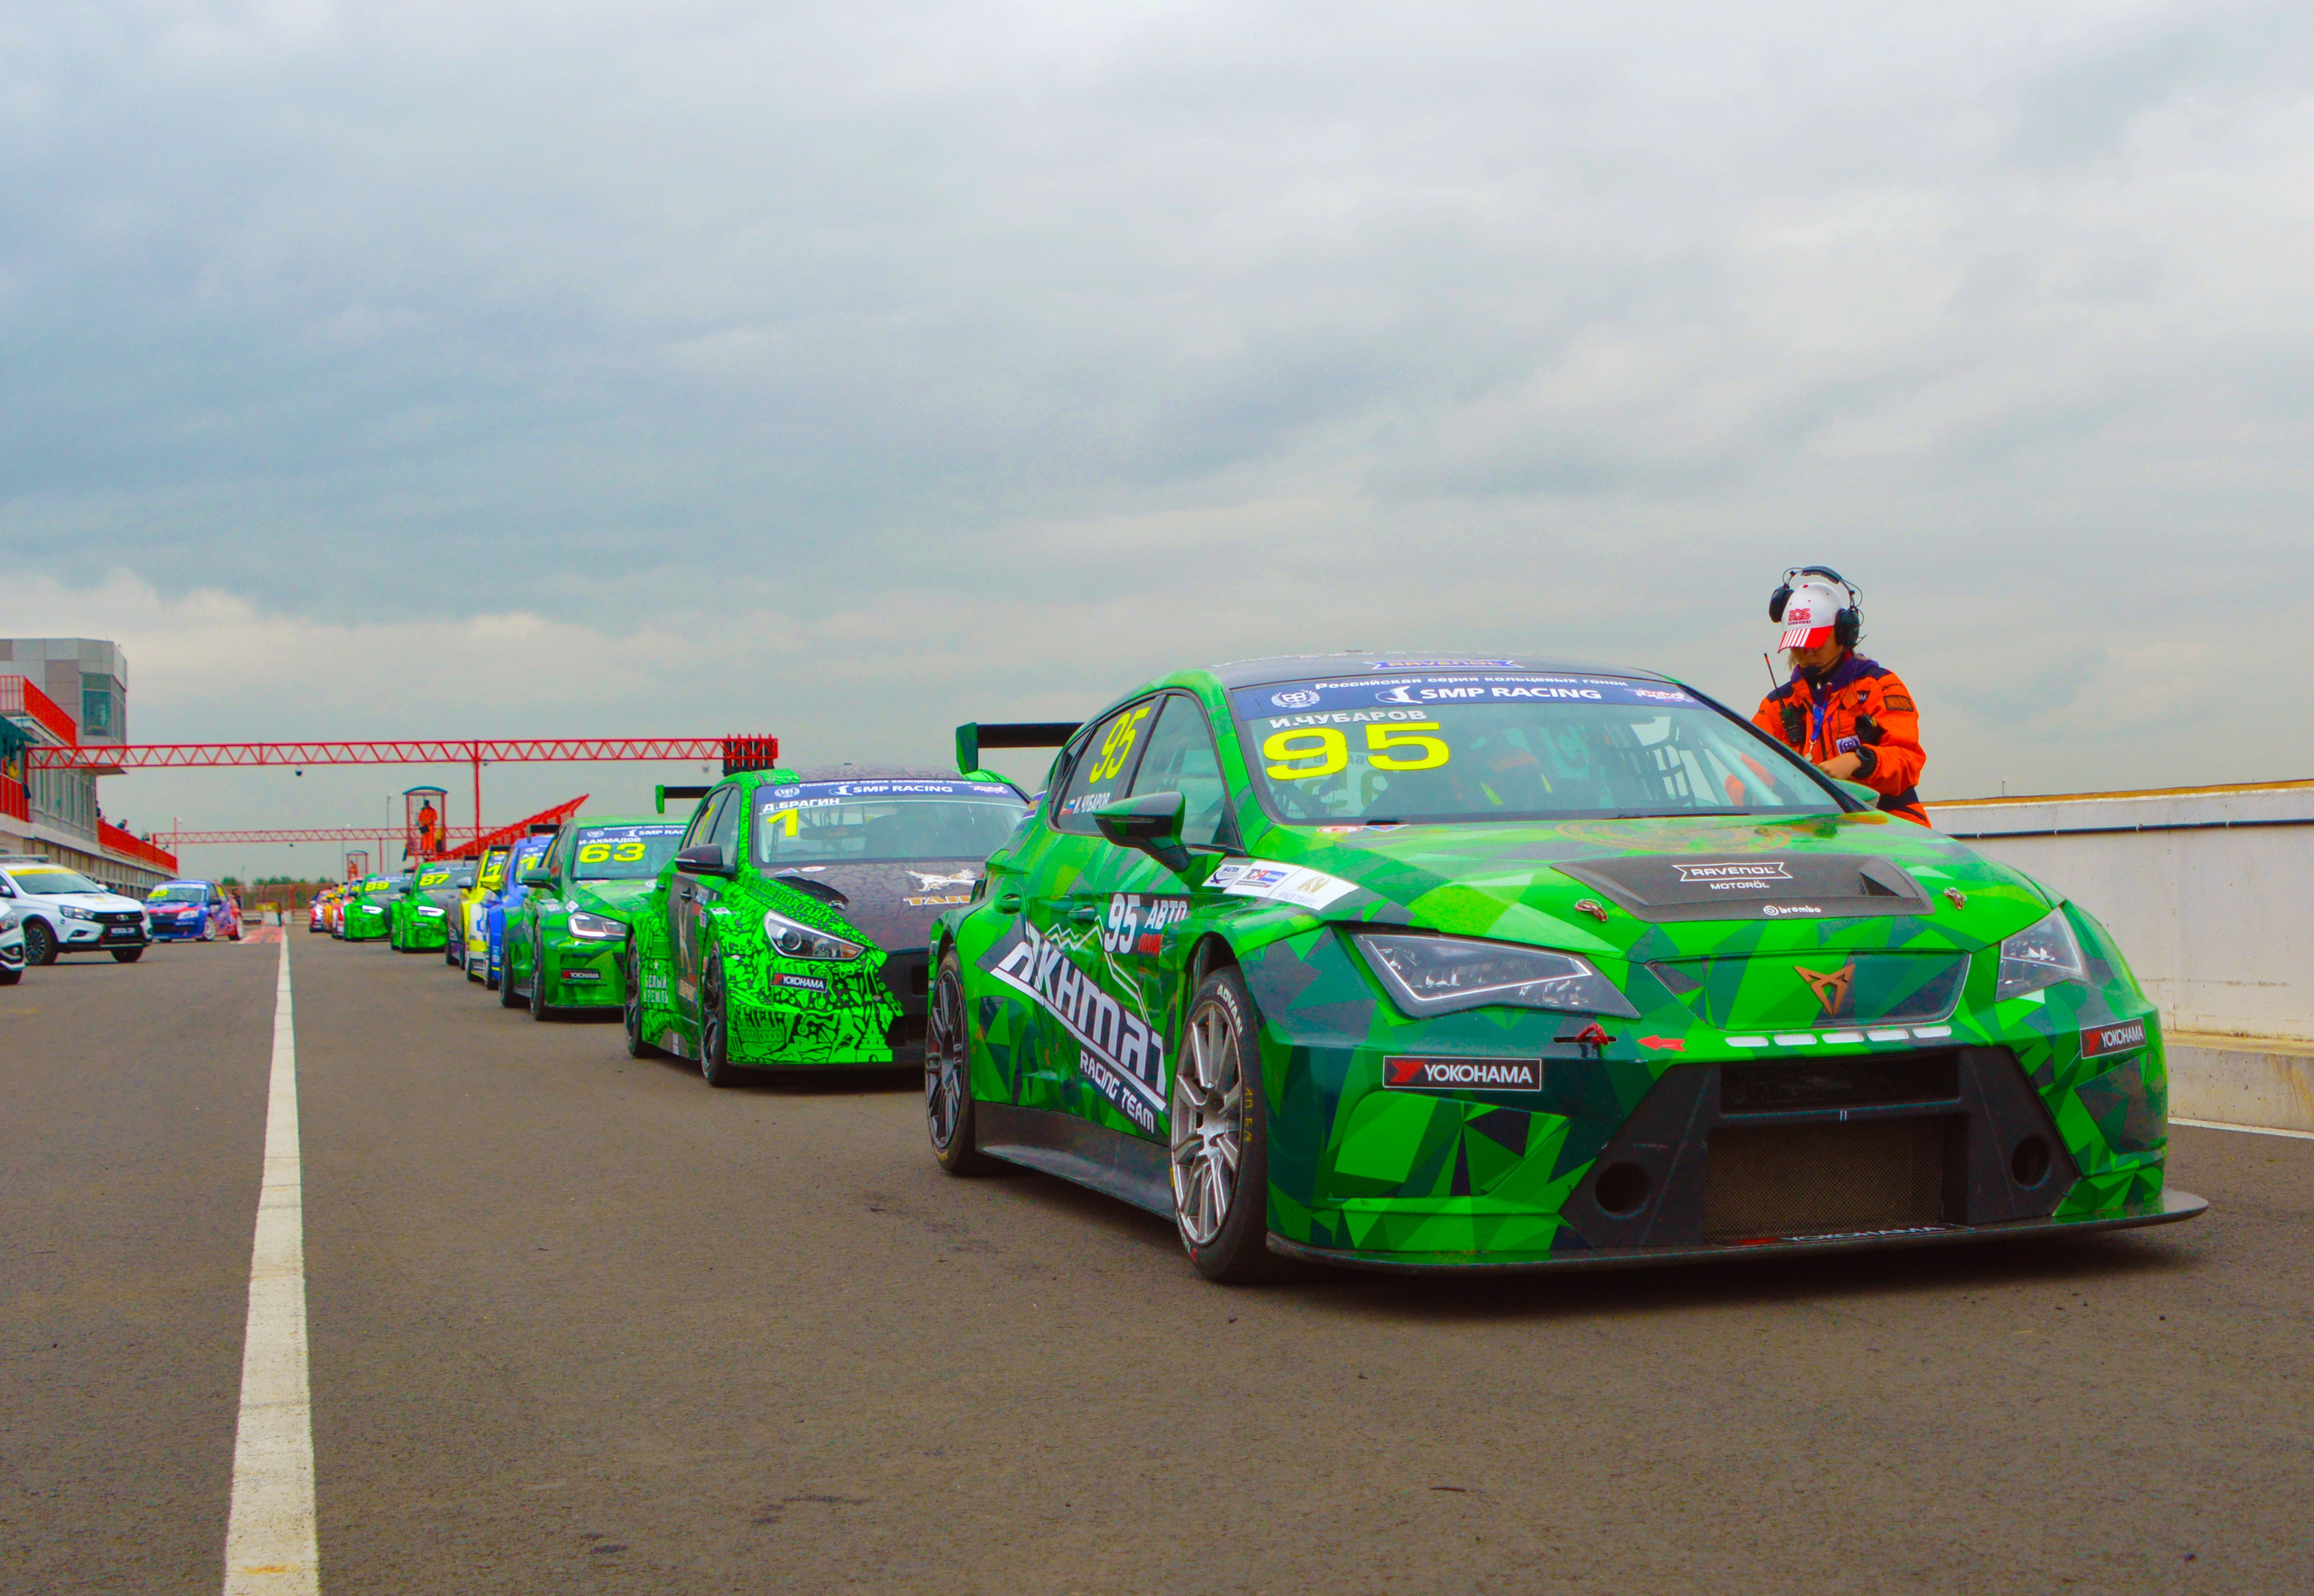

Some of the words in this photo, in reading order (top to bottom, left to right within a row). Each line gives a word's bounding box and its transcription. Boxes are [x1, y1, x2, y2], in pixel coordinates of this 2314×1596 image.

[1314, 679, 1422, 690] Российская
[1426, 677, 1480, 685] серия
[1483, 676, 1578, 684] кольцевых
[1582, 679, 1629, 687] гонок
[1420, 688, 1485, 699] SMP
[1491, 687, 1603, 699] RACING
[1269, 710, 1427, 729] И.ЧУБАРОВ
[1088, 706, 1152, 784] 95
[1263, 722, 1451, 781] 95
[852, 785, 889, 793] SMP
[892, 784, 954, 793] RACING
[762, 798, 841, 812] Д.БРАГИН
[767, 808, 799, 837] 1
[578, 842, 646, 863] 63
[419, 873, 450, 887] 87
[1710, 880, 1770, 890] MOTORÖL
[1778, 906, 1821, 914] brembo
[1104, 893, 1141, 953] 95
[782, 976, 824, 990] YOKOHAMA
[1217, 984, 1244, 1037] ADVAN
[2100, 1024, 2144, 1048] YOKOHAMA
[1424, 1064, 1533, 1084] YOKOHAMA
[1079, 1049, 1120, 1101] RACING
[1121, 1087, 1154, 1134] TEAM
